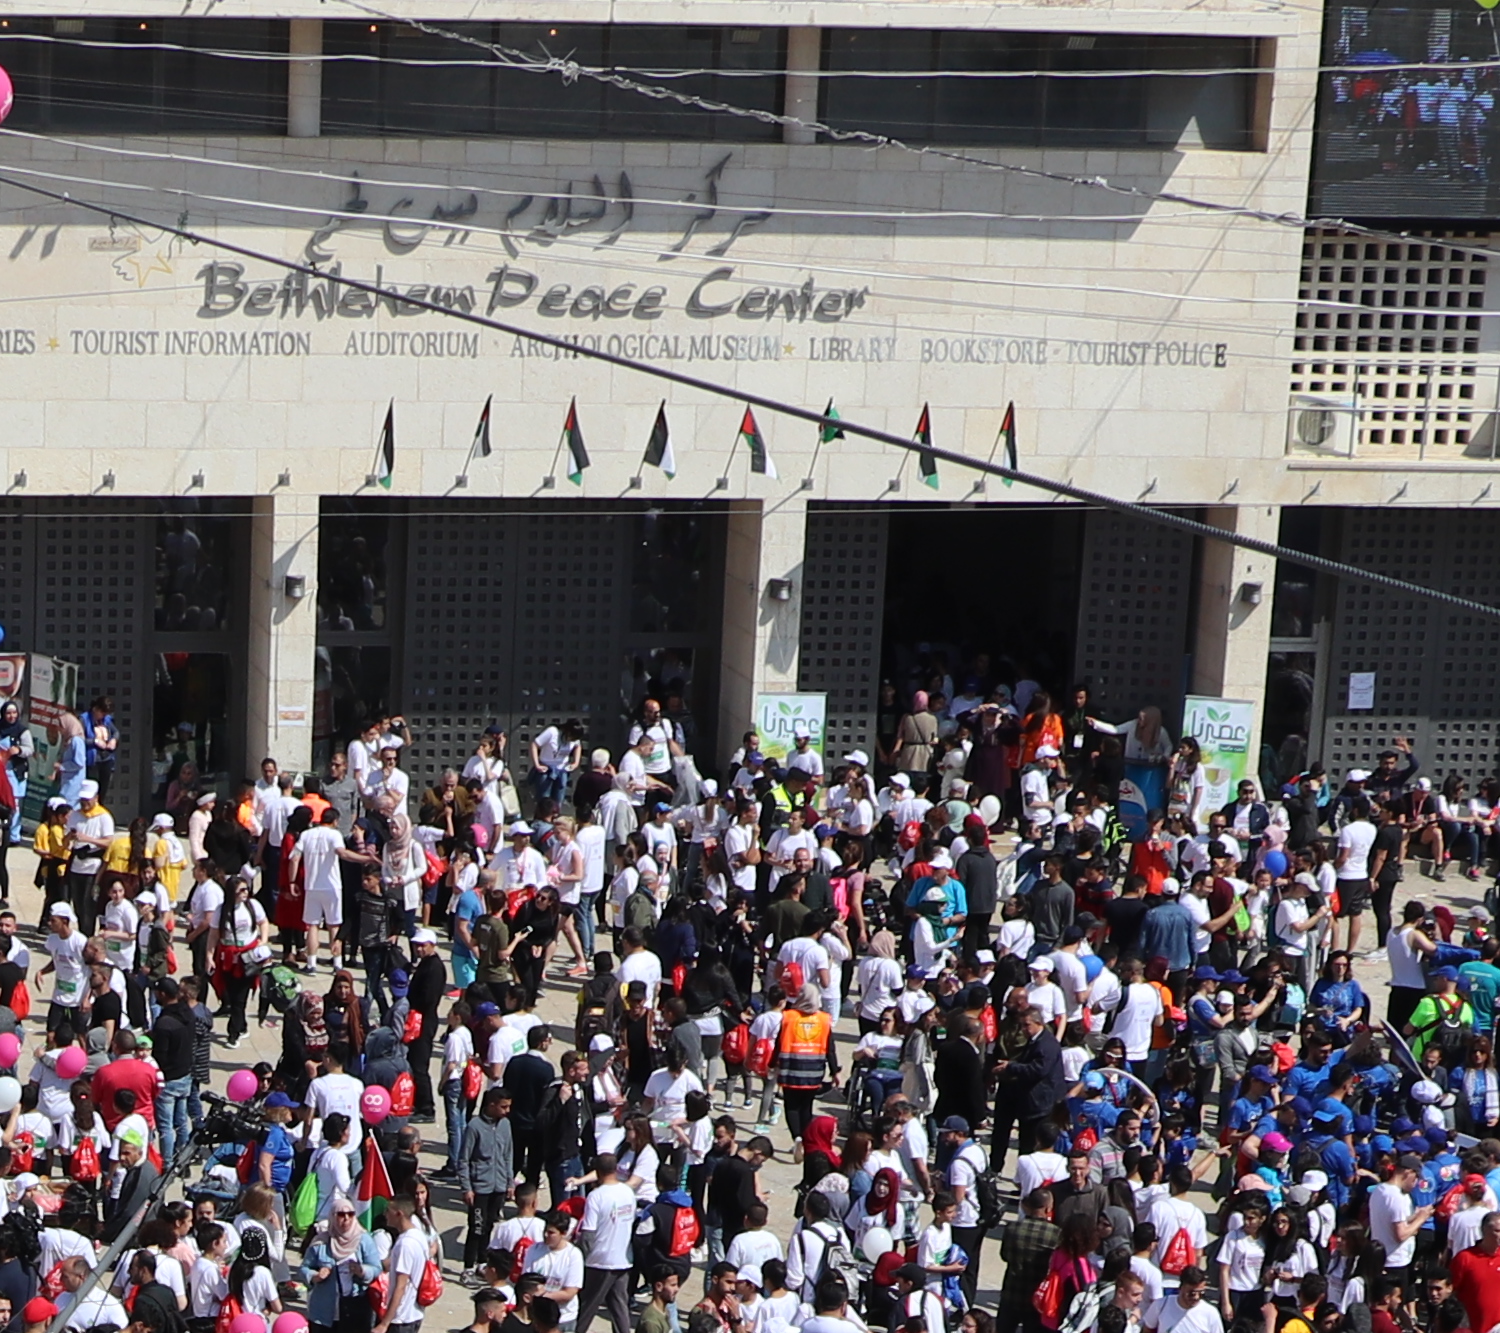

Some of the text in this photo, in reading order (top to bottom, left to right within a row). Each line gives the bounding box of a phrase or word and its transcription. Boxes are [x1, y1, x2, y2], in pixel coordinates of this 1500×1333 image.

[196, 259, 873, 324] Bethlehem Peace Center
[70, 330, 157, 356] TOURIST
[164, 330, 311, 357] INFORMATION
[343, 331, 480, 358] AUDITORIUM
[687, 333, 781, 362] MUSEUM
[809, 336, 897, 362] LIBRARY
[920, 336, 1049, 366] BOOKSTORE
[1066, 339, 1153, 367] TOURIST
[1153, 340, 1228, 369] POLICE
